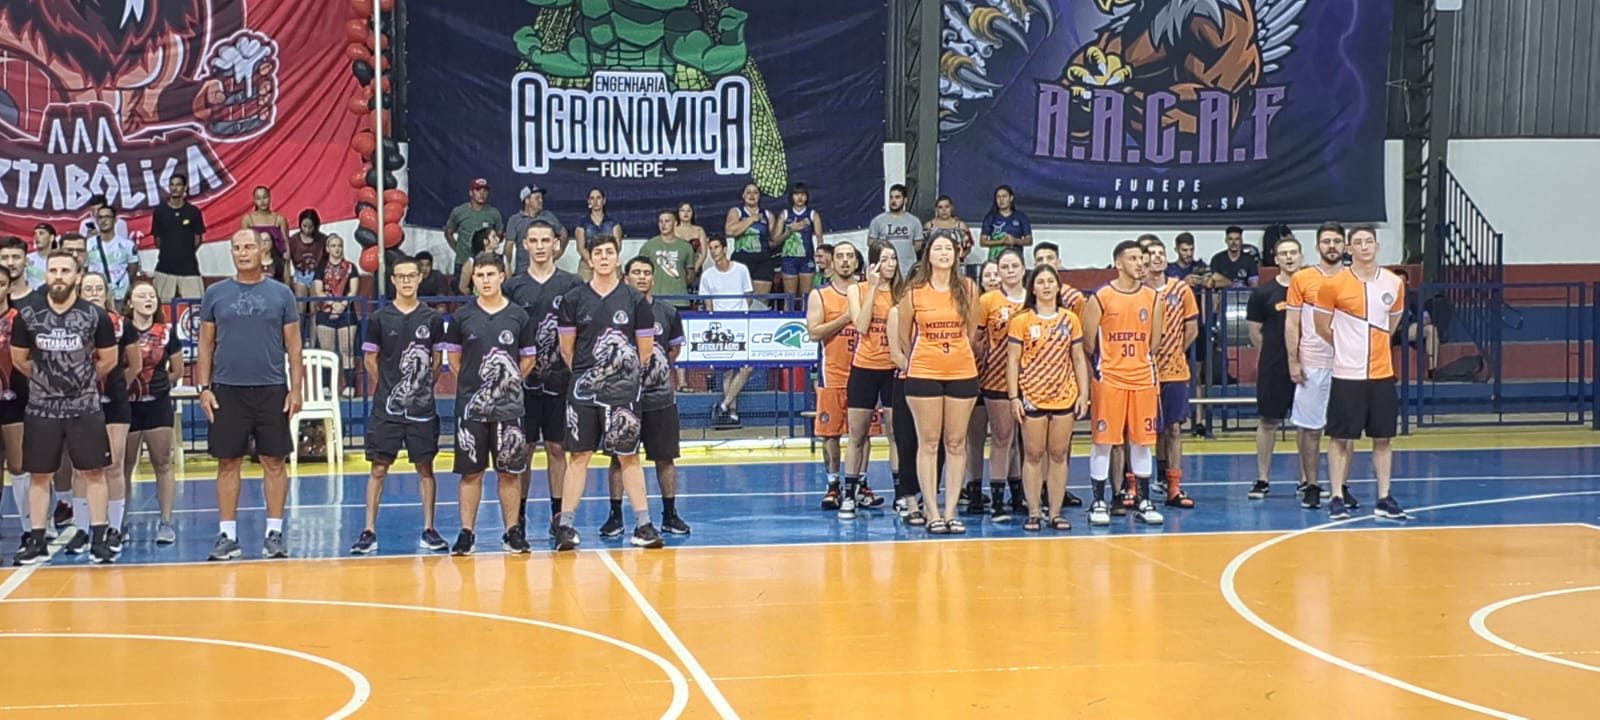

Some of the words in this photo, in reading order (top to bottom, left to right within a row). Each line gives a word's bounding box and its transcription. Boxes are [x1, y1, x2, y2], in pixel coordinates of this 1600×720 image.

[595, 75, 666, 92] ENGENHARIA
[601, 162, 664, 178] FUNEPE
[1115, 178, 1201, 193] FUNEPE
[887, 223, 909, 236] Lee
[1121, 343, 1136, 358] 30
